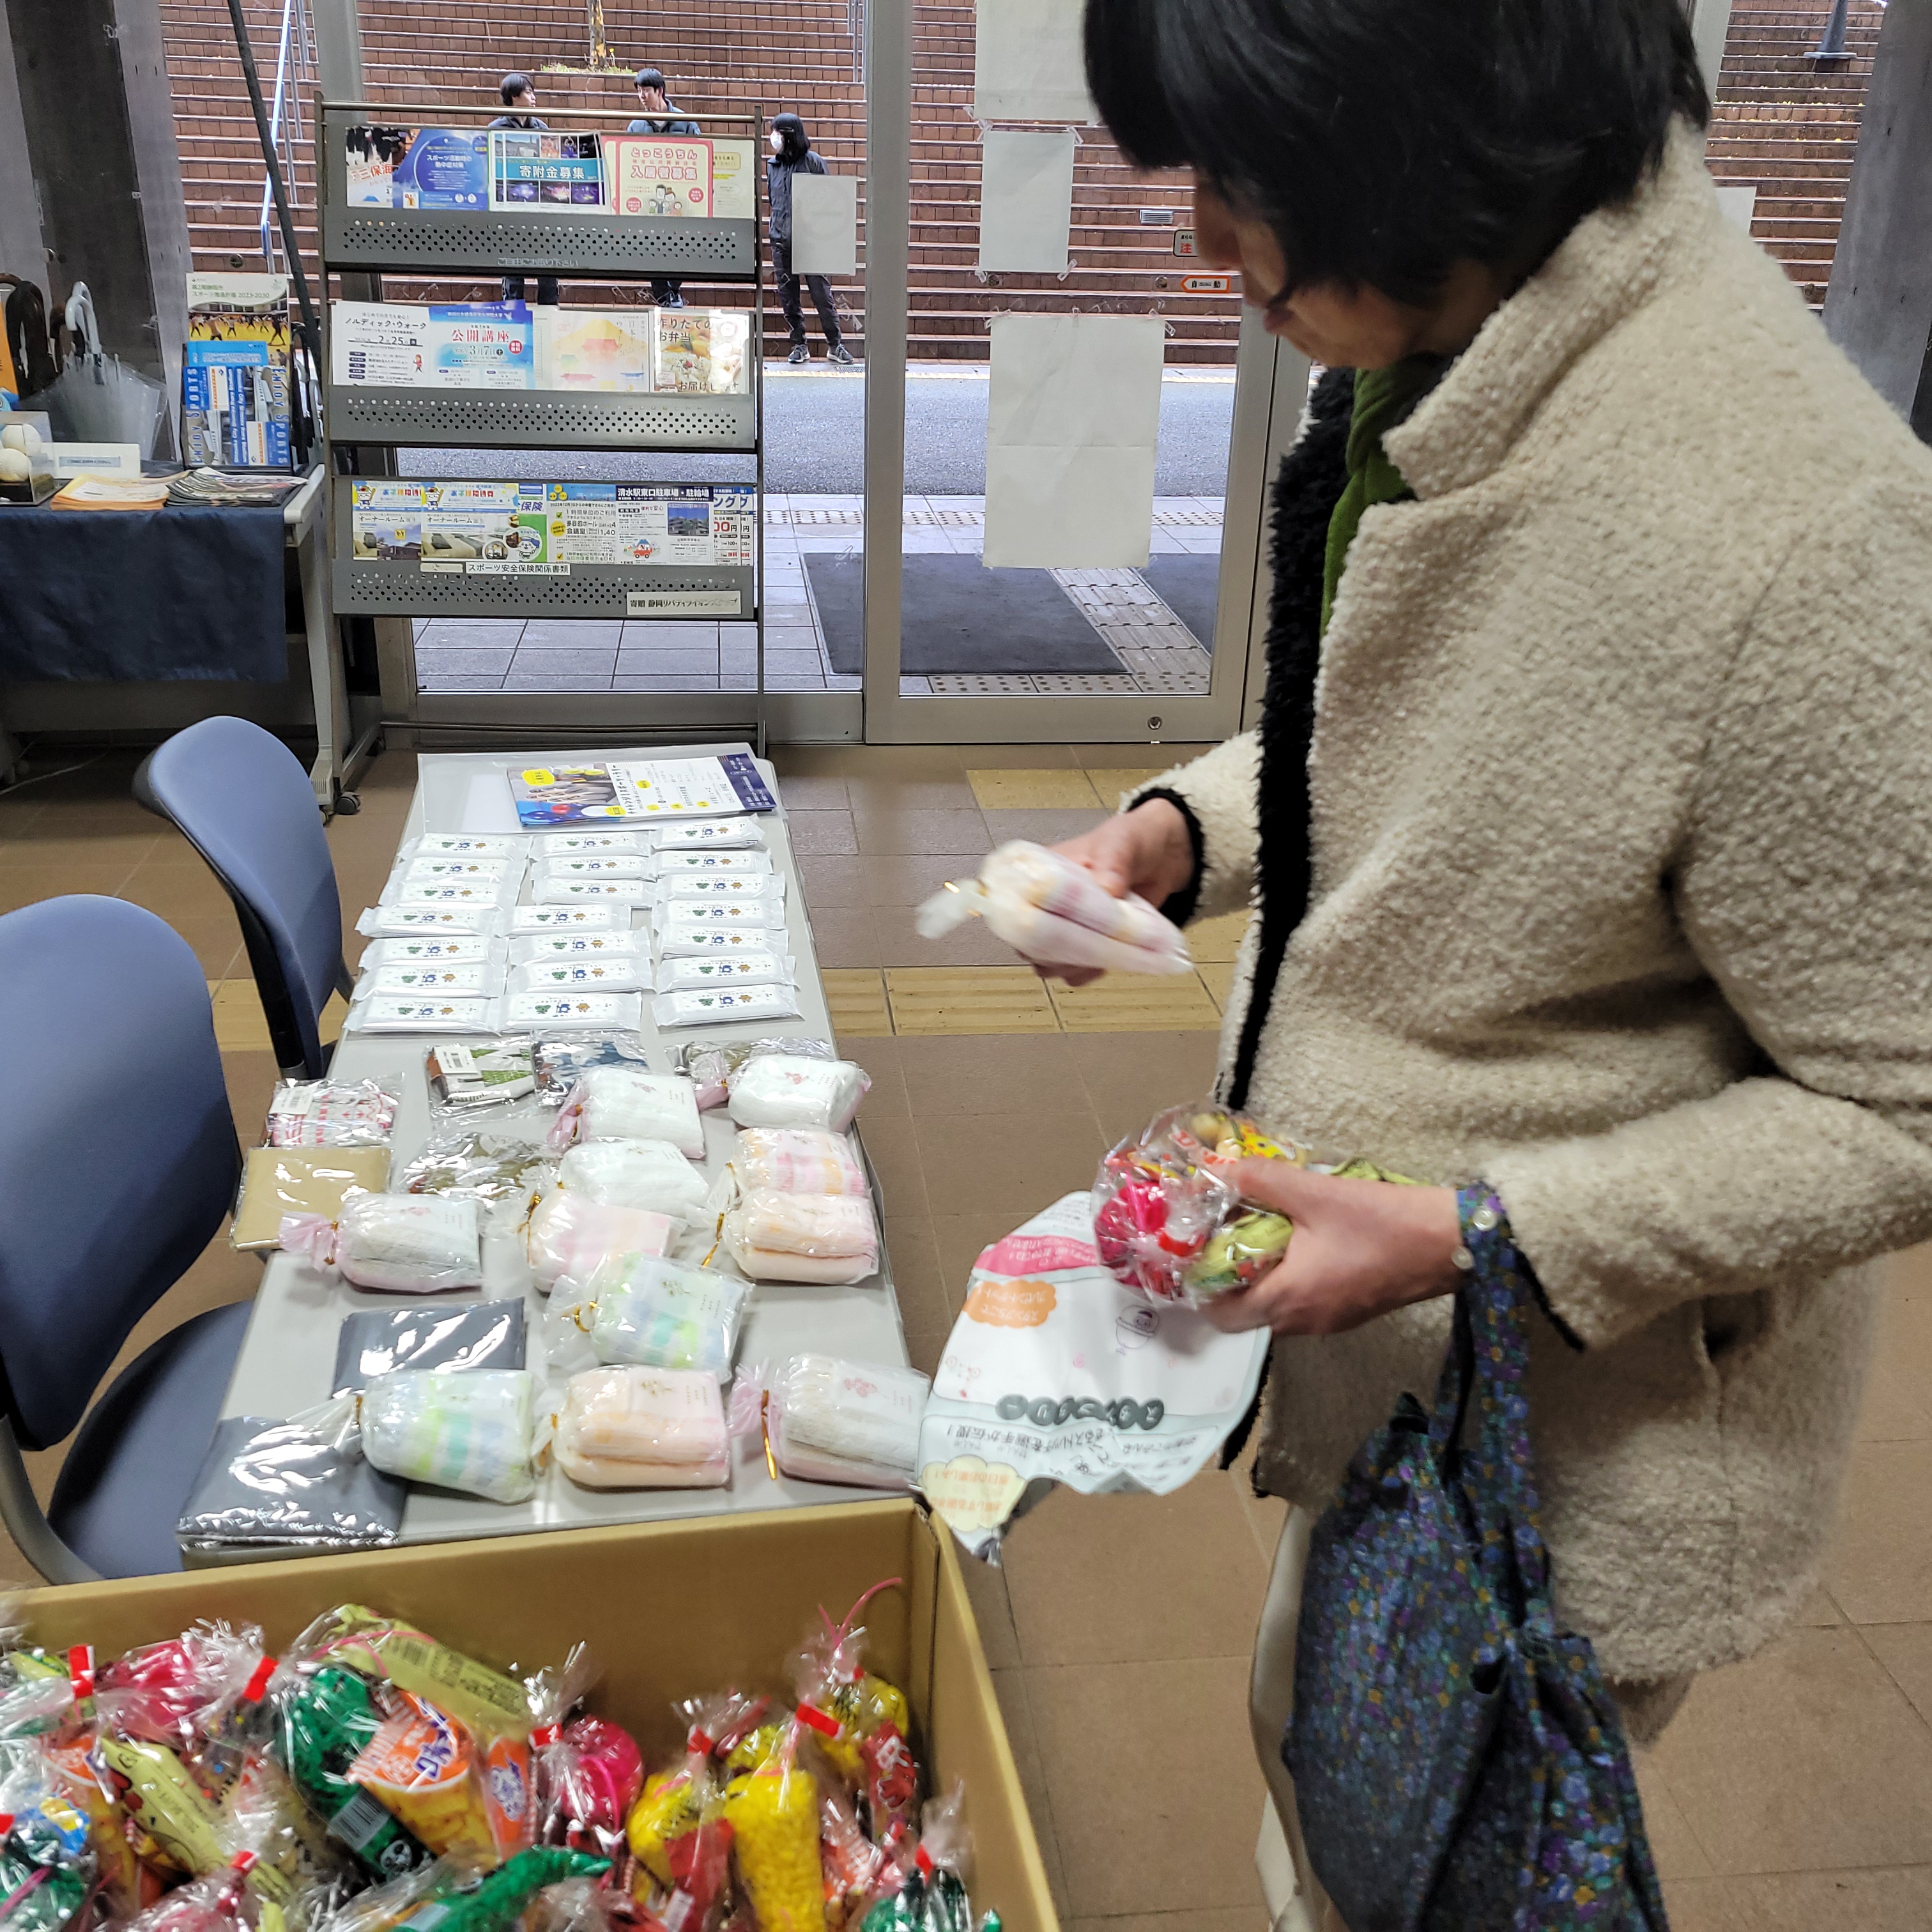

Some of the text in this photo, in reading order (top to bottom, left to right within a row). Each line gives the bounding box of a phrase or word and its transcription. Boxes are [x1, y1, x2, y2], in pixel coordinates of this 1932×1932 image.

[631, 148, 697, 160] とっこうちん
[519, 165, 585, 180] 寄附金募集
[345, 318, 426, 329] ノルディック・ウォーク
[452, 329, 509, 343] 公開講座
[661, 331, 690, 343] お弁当
[186, 369, 201, 417] SPORTS
[272, 369, 289, 463] ENJOY SPORTS
[521, 502, 542, 511] 保険
[468, 564, 569, 574] スポーツ安全保険関係書類
